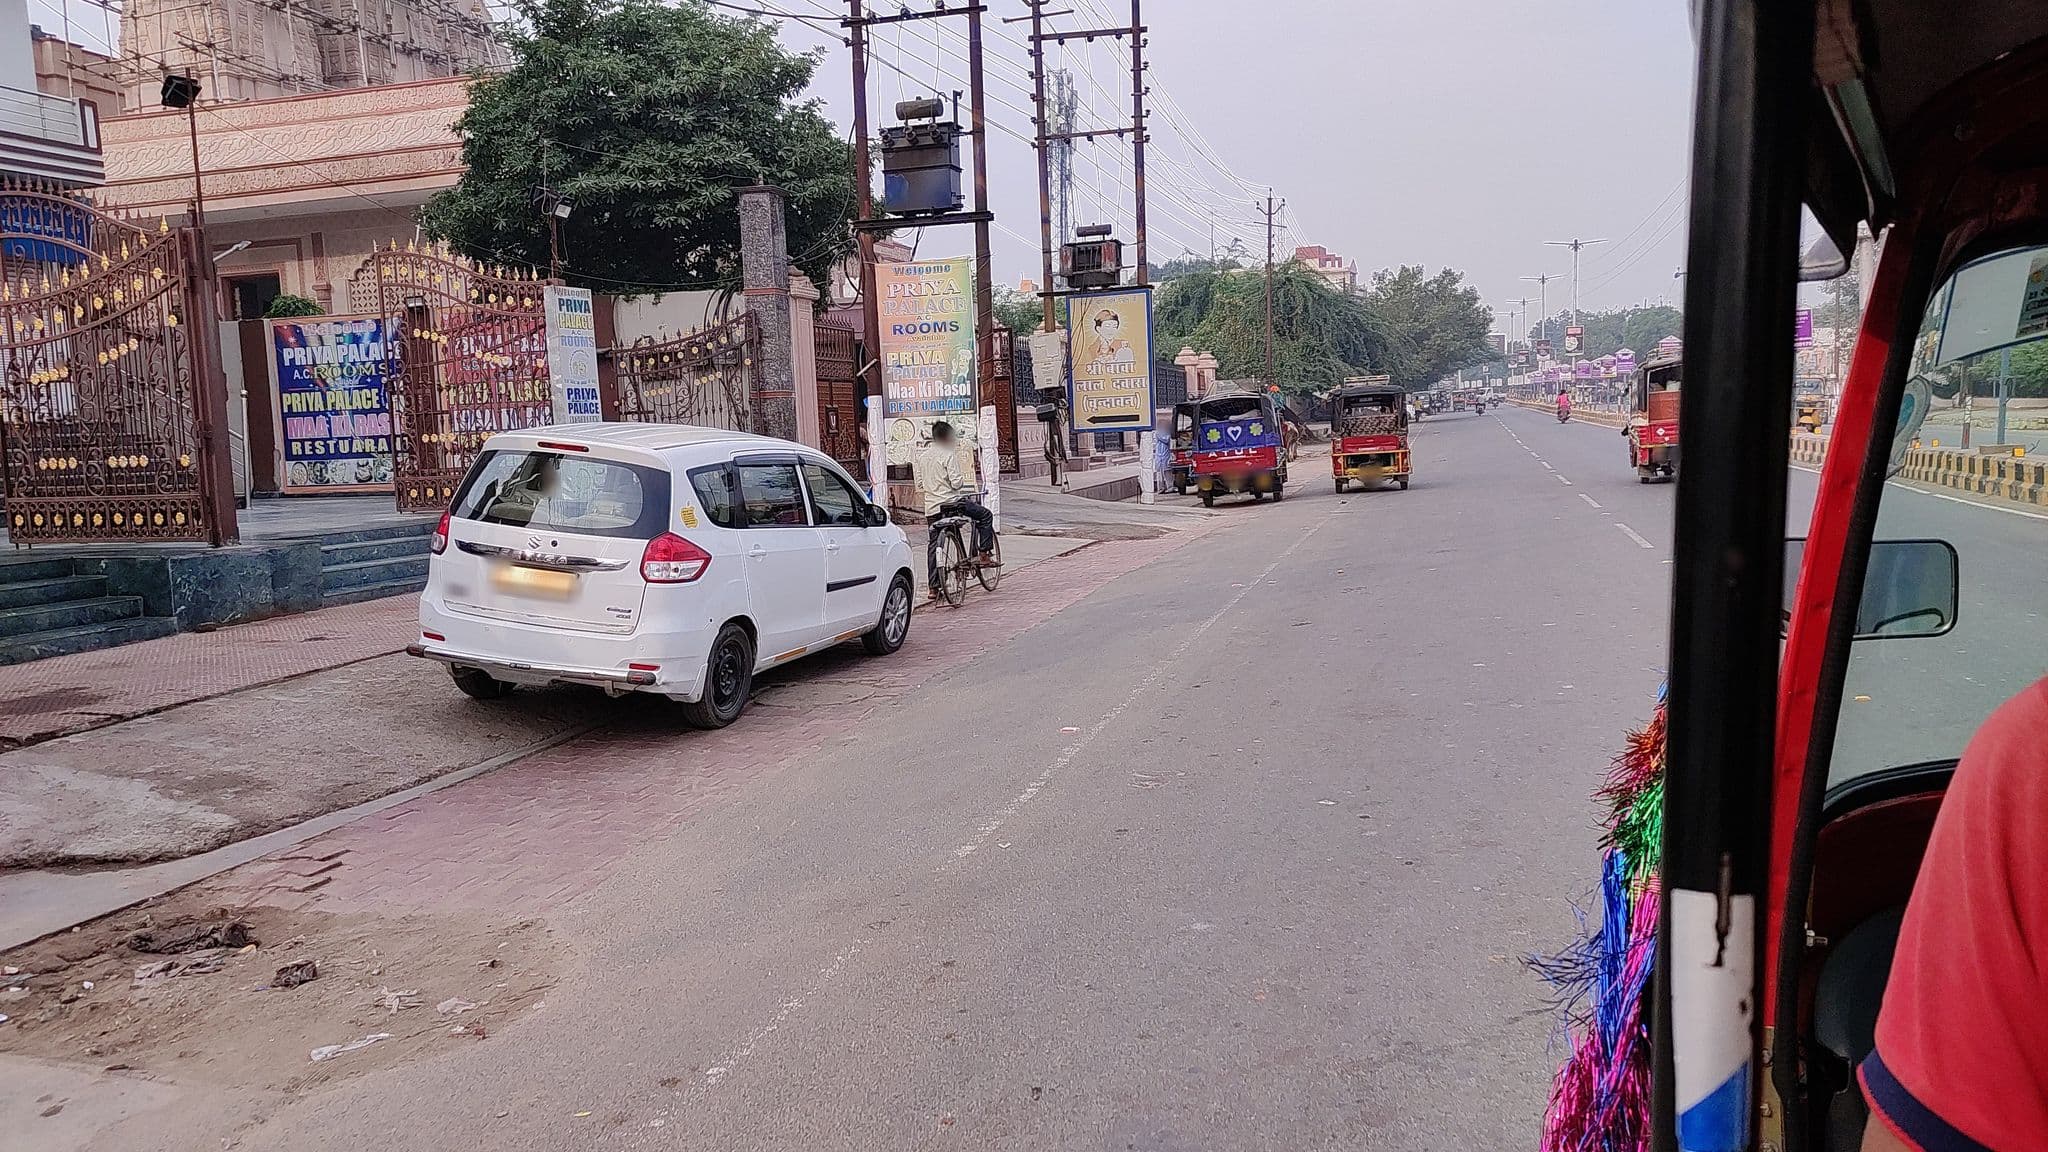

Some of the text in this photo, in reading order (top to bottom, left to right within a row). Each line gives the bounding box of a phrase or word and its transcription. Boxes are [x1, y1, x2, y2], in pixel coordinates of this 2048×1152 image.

[893, 264, 951, 276] Welcome
[887, 279, 961, 298] PRIYA
[558, 298, 591, 314] PRIYA
[883, 296, 967, 316] PALACE
[559, 313, 593, 330] PALACE
[892, 320, 960, 336] ROOMS
[561, 336, 594, 348] ROOMS
[283, 341, 401, 366] PRIYA PALACE
[886, 351, 945, 366] PRIYA
[314, 362, 388, 380] ROOMS
[893, 365, 947, 380] PALACE
[888, 380, 971, 399] Maa Ki Rasoi
[1075, 379, 1105, 392] लाल
[282, 391, 325, 413] PRIYA
[326, 388, 381, 410] PALACE
[566, 388, 598, 401] PRIYA
[567, 402, 600, 415] PALACE
[889, 399, 971, 413] RESTUARANT
[286, 415, 330, 440] MAA
[330, 415, 353, 438] KI
